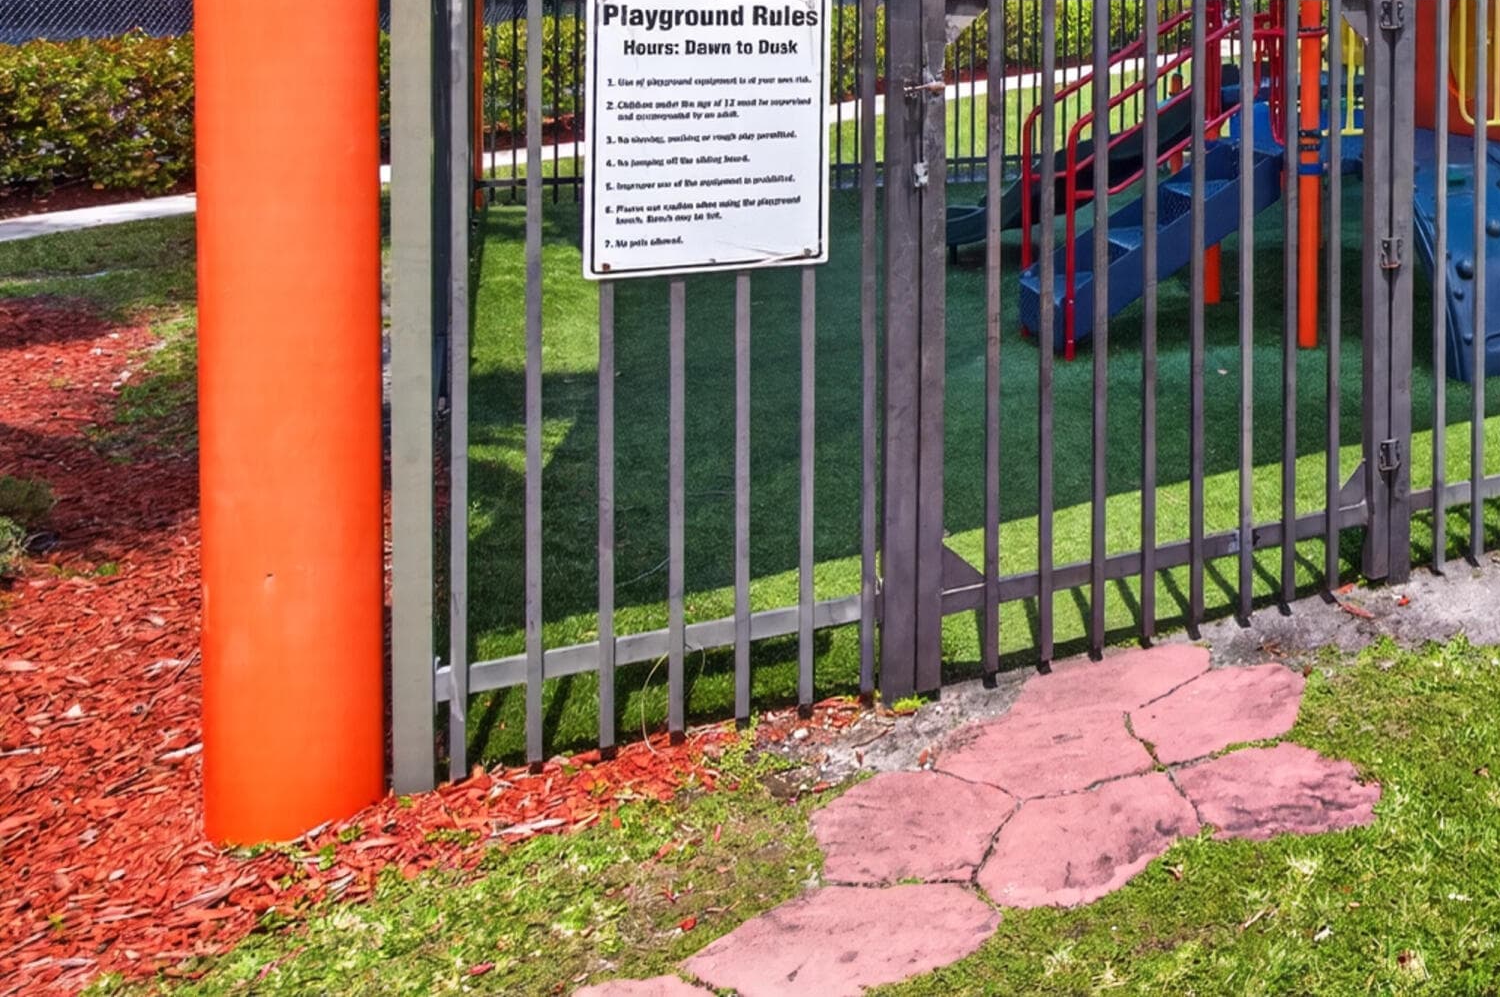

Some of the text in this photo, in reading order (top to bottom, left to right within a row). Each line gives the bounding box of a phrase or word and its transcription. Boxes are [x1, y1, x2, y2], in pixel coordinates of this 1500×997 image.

[603, 4, 818, 31] Playground Rules
[624, 40, 798, 55] Hours: Dawn to Dusk
